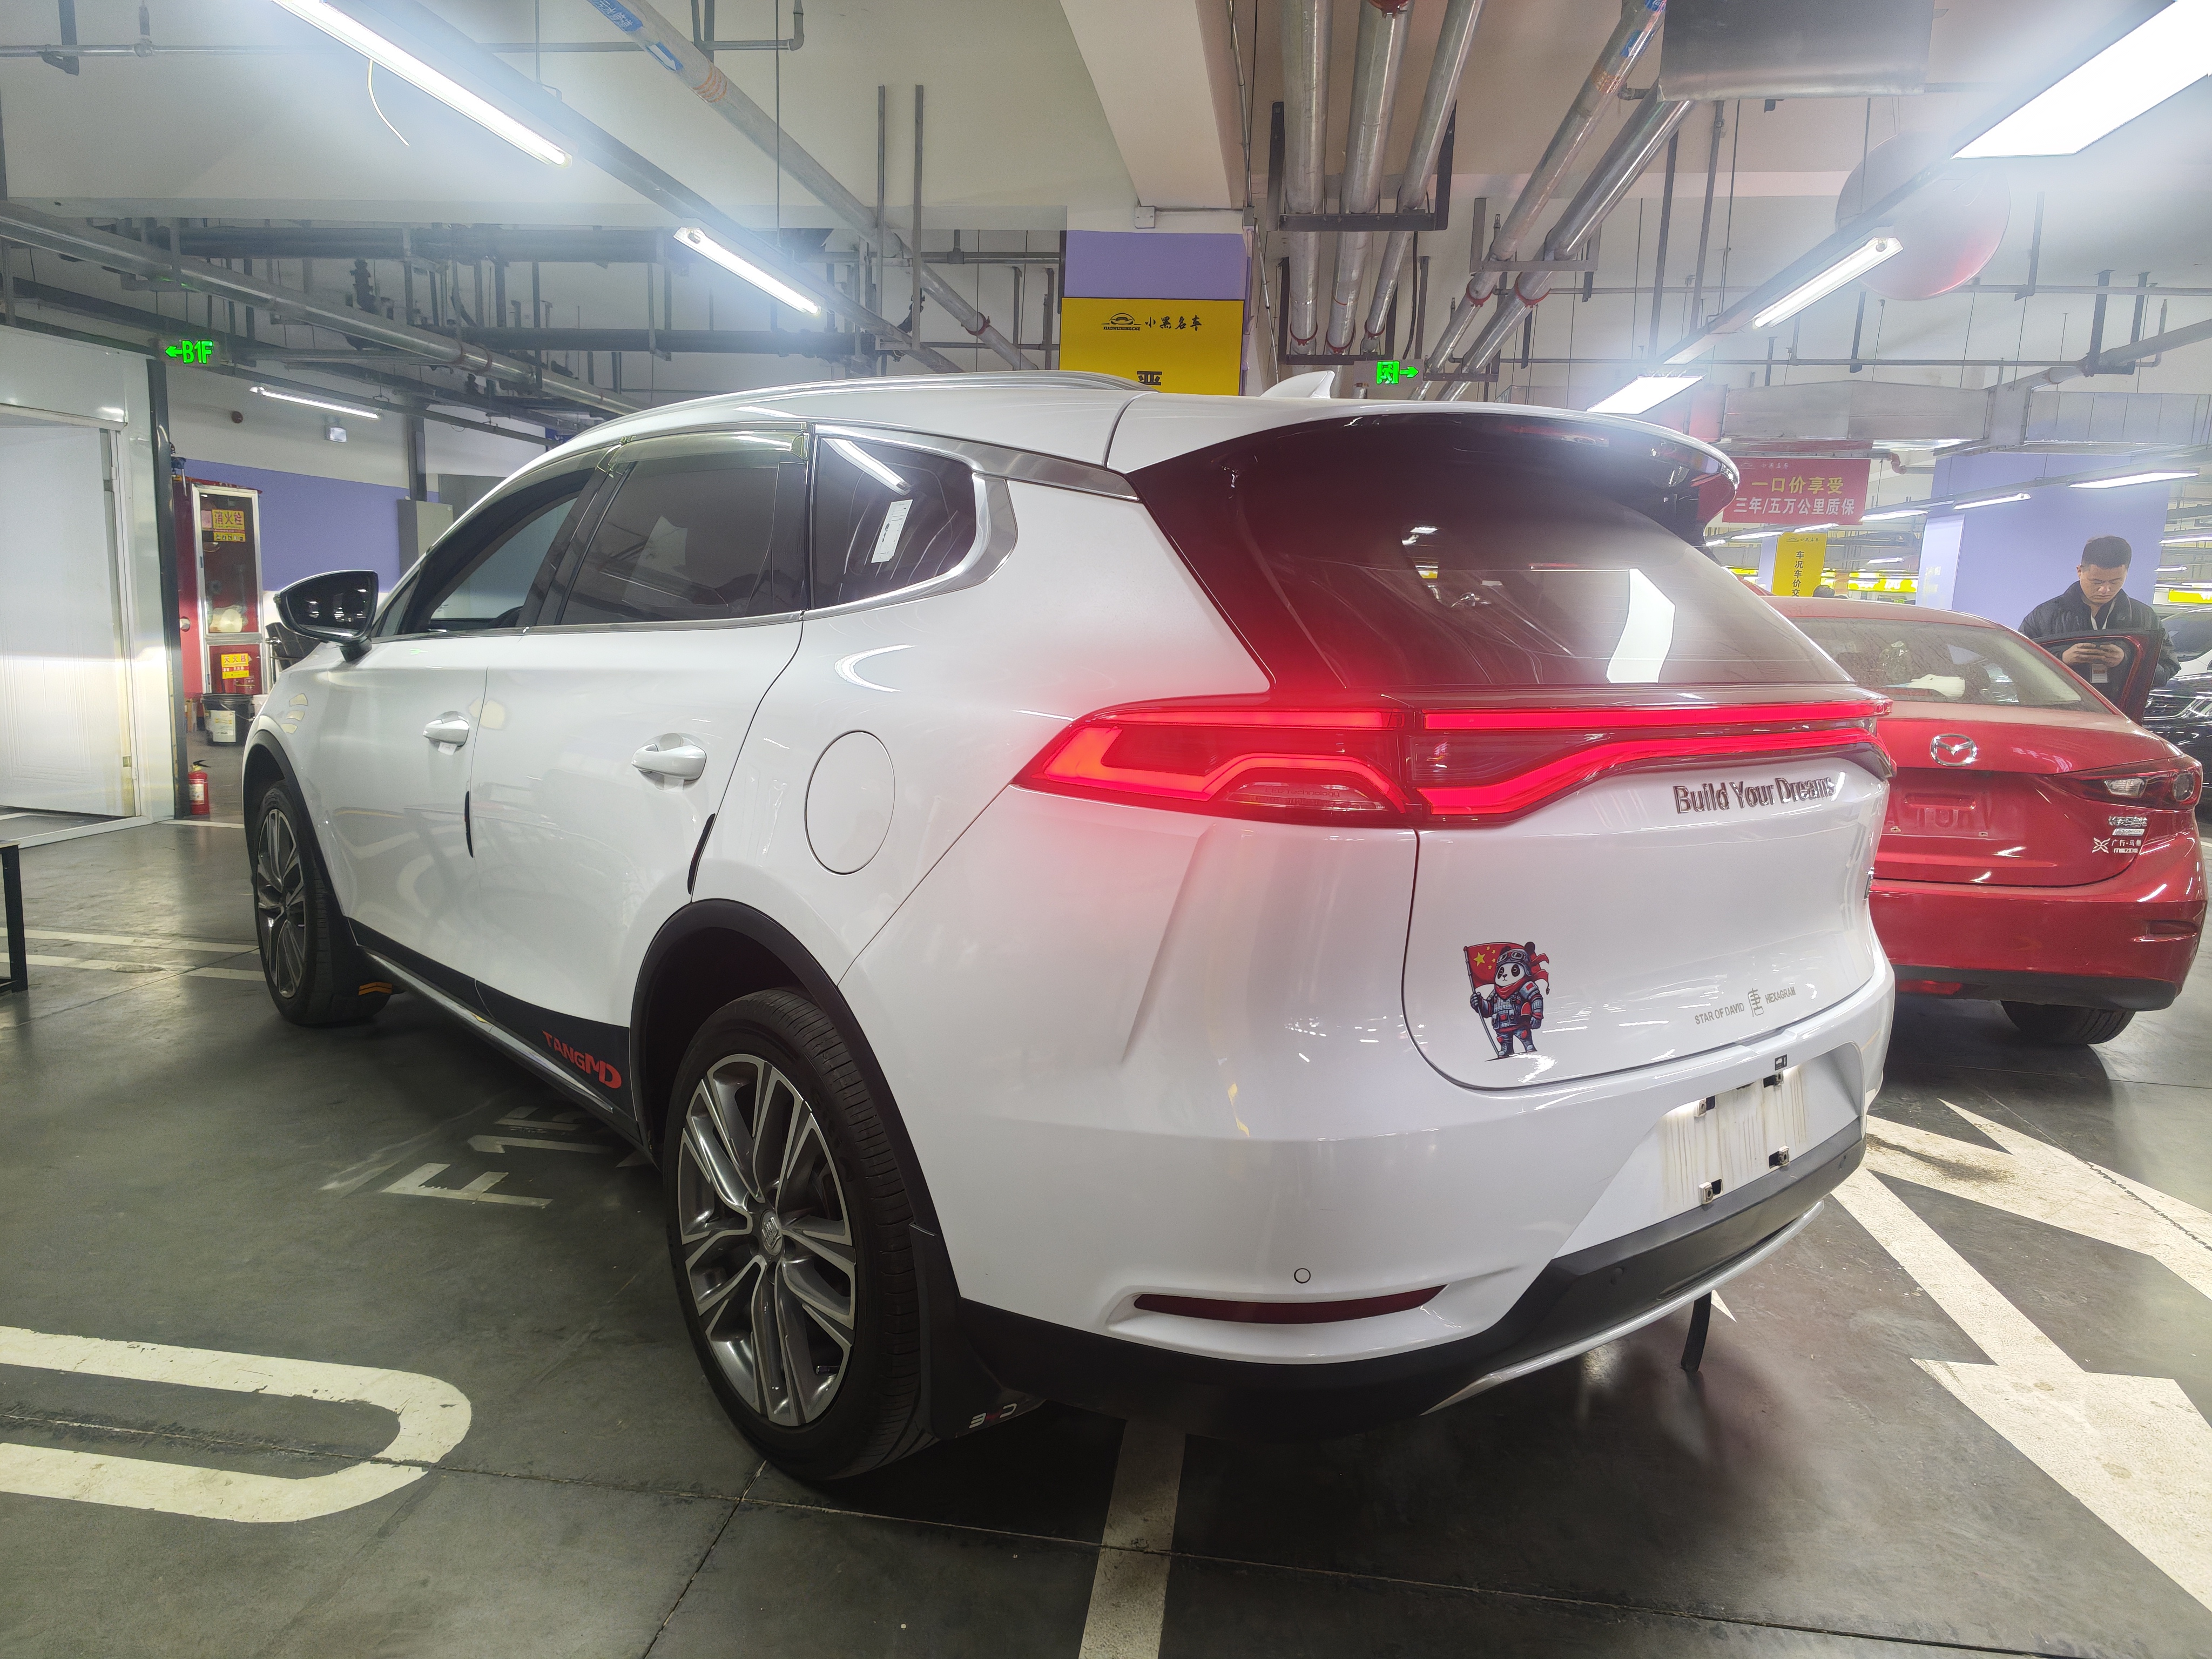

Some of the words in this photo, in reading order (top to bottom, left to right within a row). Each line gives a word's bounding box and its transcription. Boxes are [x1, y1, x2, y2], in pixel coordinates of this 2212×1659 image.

[181, 340, 214, 365] B1F
[1751, 476, 1844, 495] 一口价享受
[1733, 497, 1855, 516] 三年/五万公里质保
[1673, 782, 1730, 814] Build
[1729, 780, 1775, 809] Your
[1775, 777, 1836, 804] Dreams
[1764, 987, 1796, 1004] HEXAGRAM
[1695, 1011, 1714, 1025] STAR
[1714, 1008, 1724, 1019] OF
[1724, 1002, 1745, 1016] DAVID
